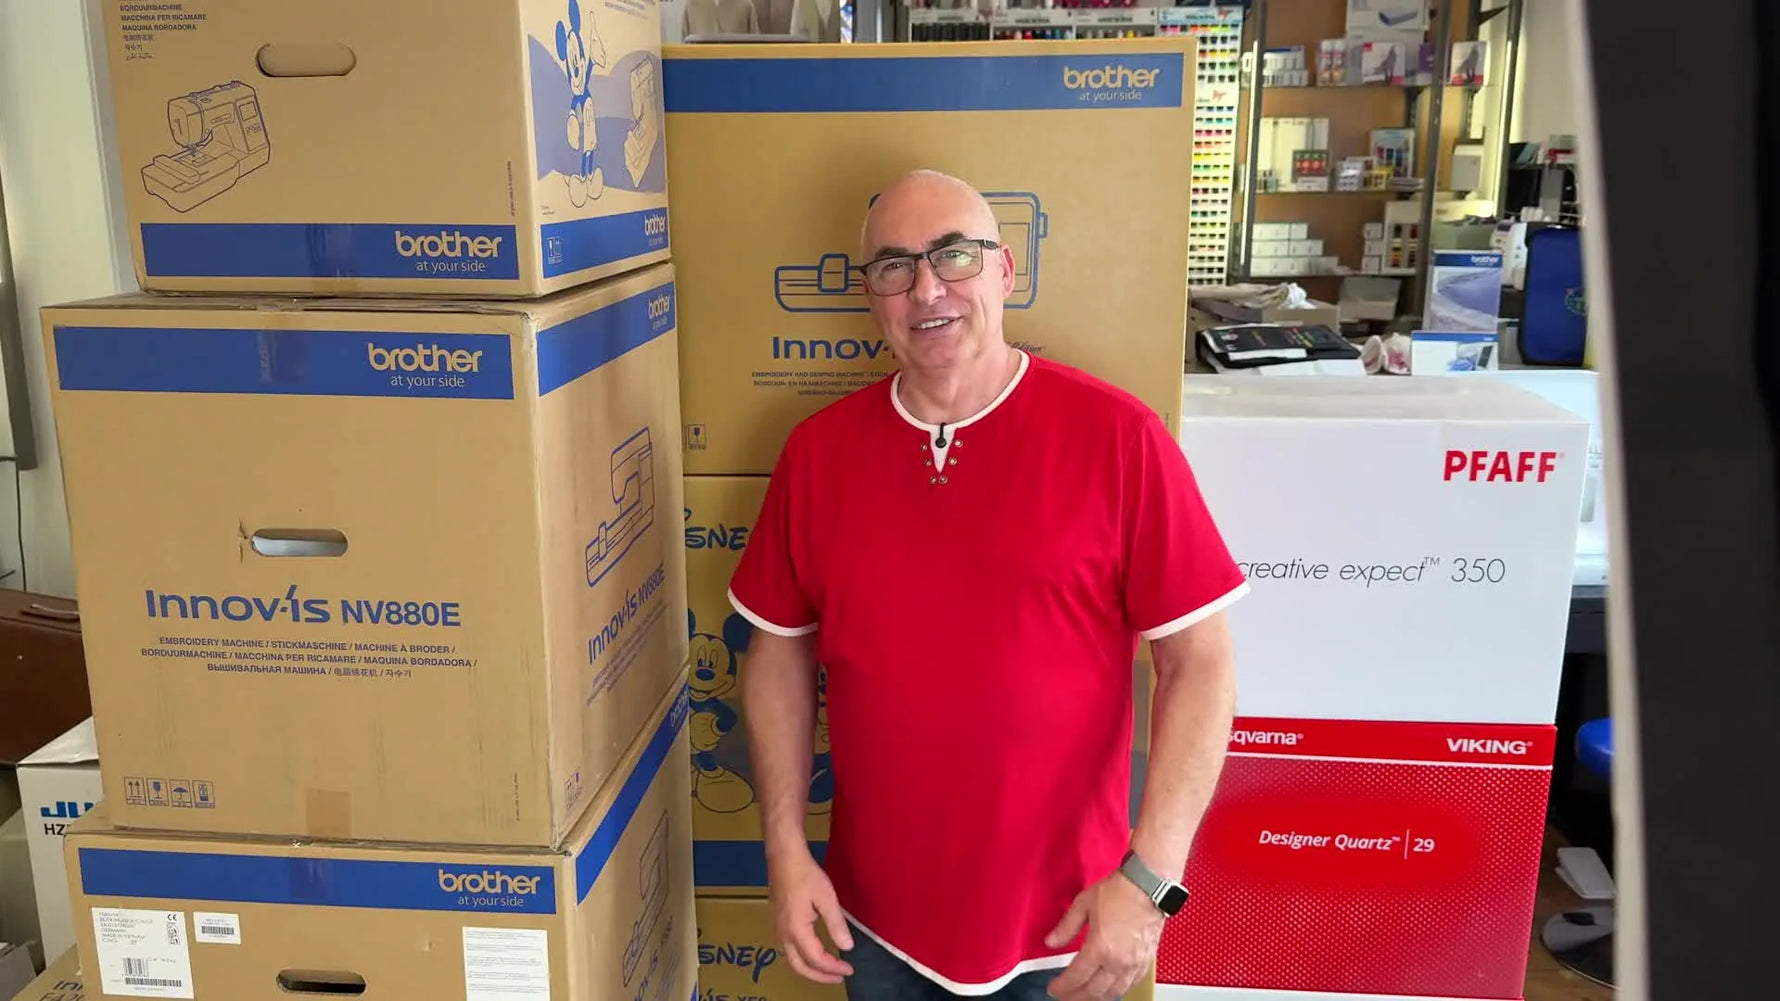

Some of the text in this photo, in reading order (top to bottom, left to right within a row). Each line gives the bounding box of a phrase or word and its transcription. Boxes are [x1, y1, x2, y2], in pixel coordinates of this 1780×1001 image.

[1063, 65, 1160, 88] brother
[1079, 89, 1142, 104] at your side
[644, 212, 666, 236] brother
[395, 230, 502, 257] brother
[416, 259, 486, 274] at your side
[648, 293, 671, 319] brother
[367, 342, 482, 372] brother
[391, 374, 465, 389] at your side
[1443, 450, 1557, 483] PFAFF
[1236, 558, 1329, 580] creative
[1451, 557, 1506, 583] 350
[341, 599, 461, 627] NV880E
[159, 636, 219, 646] EMBROIDERY
[221, 638, 264, 648] MACHINE
[271, 640, 347, 651] STICKMASCHINE
[354, 642, 398, 652] MACHINE
[409, 644, 450, 654] BRODER
[141, 648, 227, 659] BORDUURMACHINE
[234, 652, 284, 661] MACCHINA
[286, 654, 305, 662] PER
[307, 654, 356, 663] RICAMARE
[364, 656, 408, 665] MAQUINA
[410, 657, 472, 667] BORDADORA
[207, 663, 282, 673] ВЫШИВАЛЬНАЯ
[284, 665, 326, 675] МАШИНА
[1258, 830, 1331, 850] Designer
[1413, 838, 1435, 852] 29
[438, 868, 541, 895] brother
[458, 895, 524, 908] at your side
